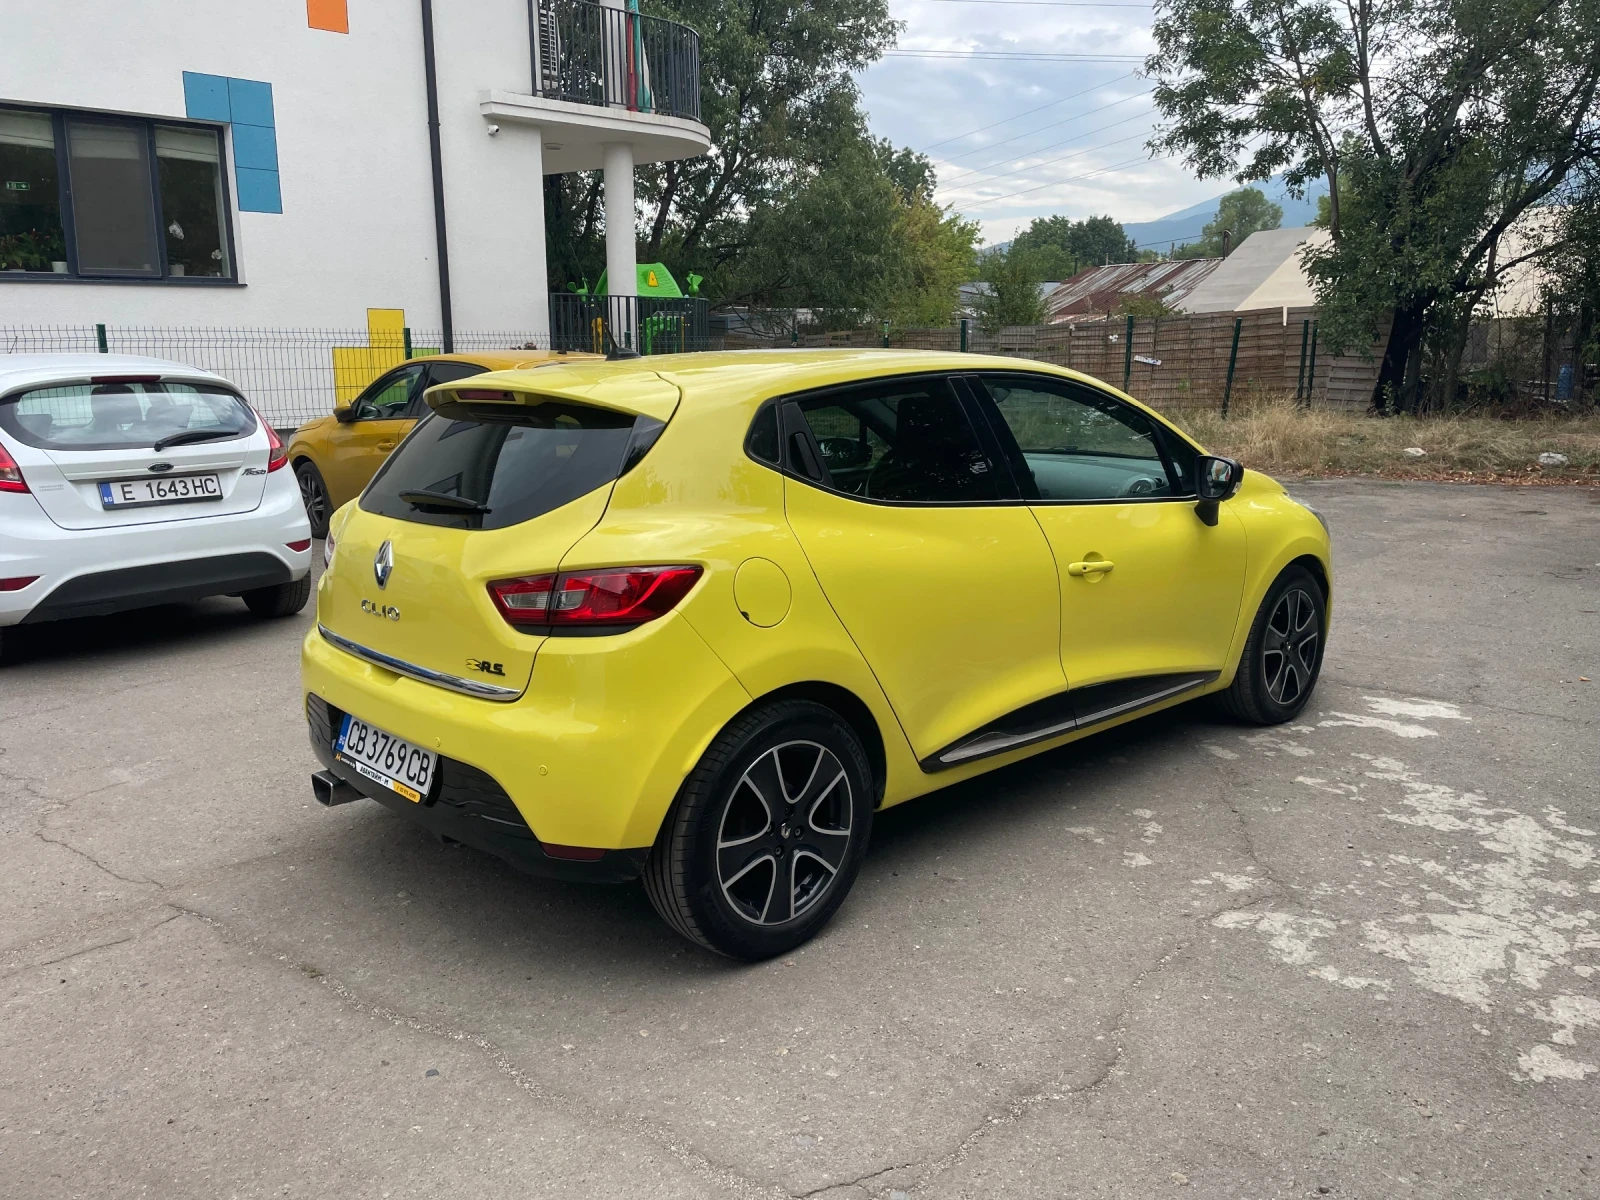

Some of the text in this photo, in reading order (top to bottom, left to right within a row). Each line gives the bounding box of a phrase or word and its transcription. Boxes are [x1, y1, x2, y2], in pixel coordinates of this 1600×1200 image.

[120, 478, 217, 501] E 1643 HC
[360, 599, 400, 622] CLIO
[366, 730, 407, 775] 3769
